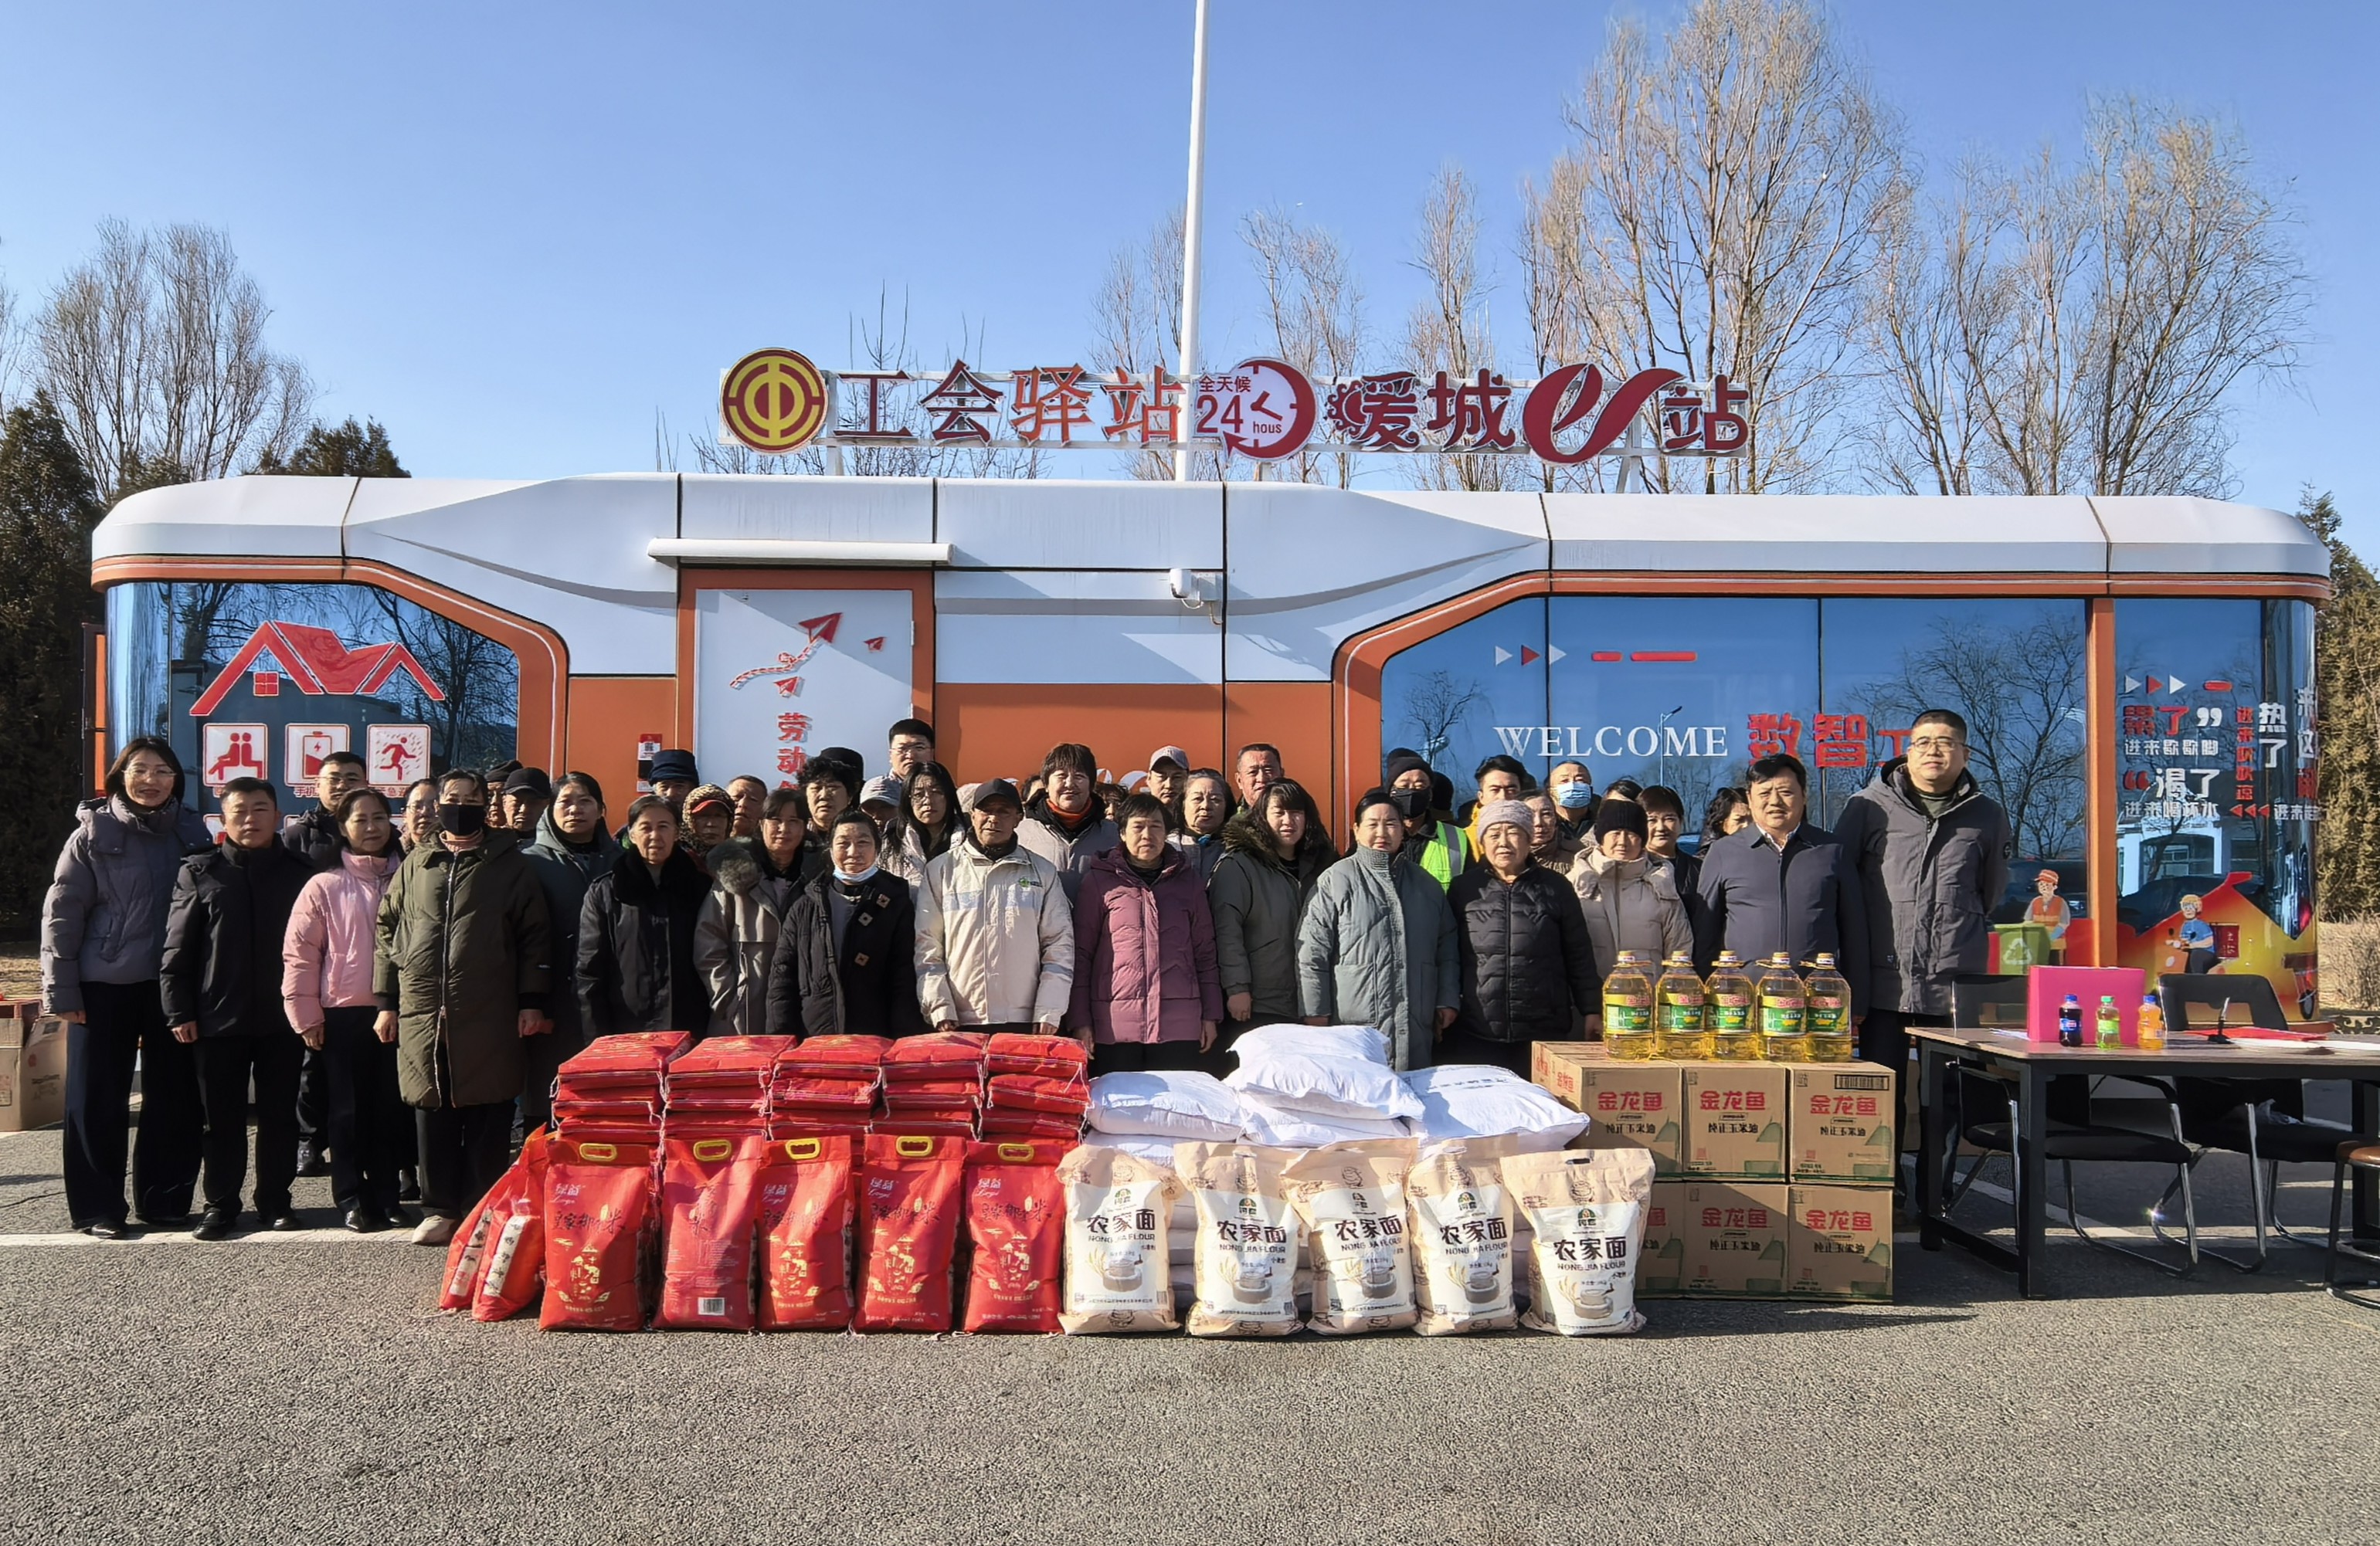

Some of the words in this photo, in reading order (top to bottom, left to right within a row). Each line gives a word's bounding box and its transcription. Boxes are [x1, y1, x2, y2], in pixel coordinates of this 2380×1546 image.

[1199, 375, 1251, 393] 全天候
[834, 359, 1187, 446] 工会驿站
[1197, 395, 1243, 434] 24
[1494, 726, 1728, 757] WELCOME
[2259, 703, 2287, 768] 热了
[777, 712, 811, 789] 劳动
[1598, 1091, 1662, 1110] 金龙鱼
[1700, 1090, 1765, 1110] 金龙鱼
[1811, 1095, 1876, 1115] 金龙鱼
[1087, 1209, 1155, 1234] 农家面
[1335, 1215, 1402, 1241] 农家面
[1702, 1207, 1767, 1228] 金龙鱼
[1806, 1209, 1872, 1231] 金龙鱼
[1217, 1220, 1286, 1243] 农家面
[1440, 1217, 1506, 1244] 农家面
[1553, 1236, 1626, 1261] 农家面
